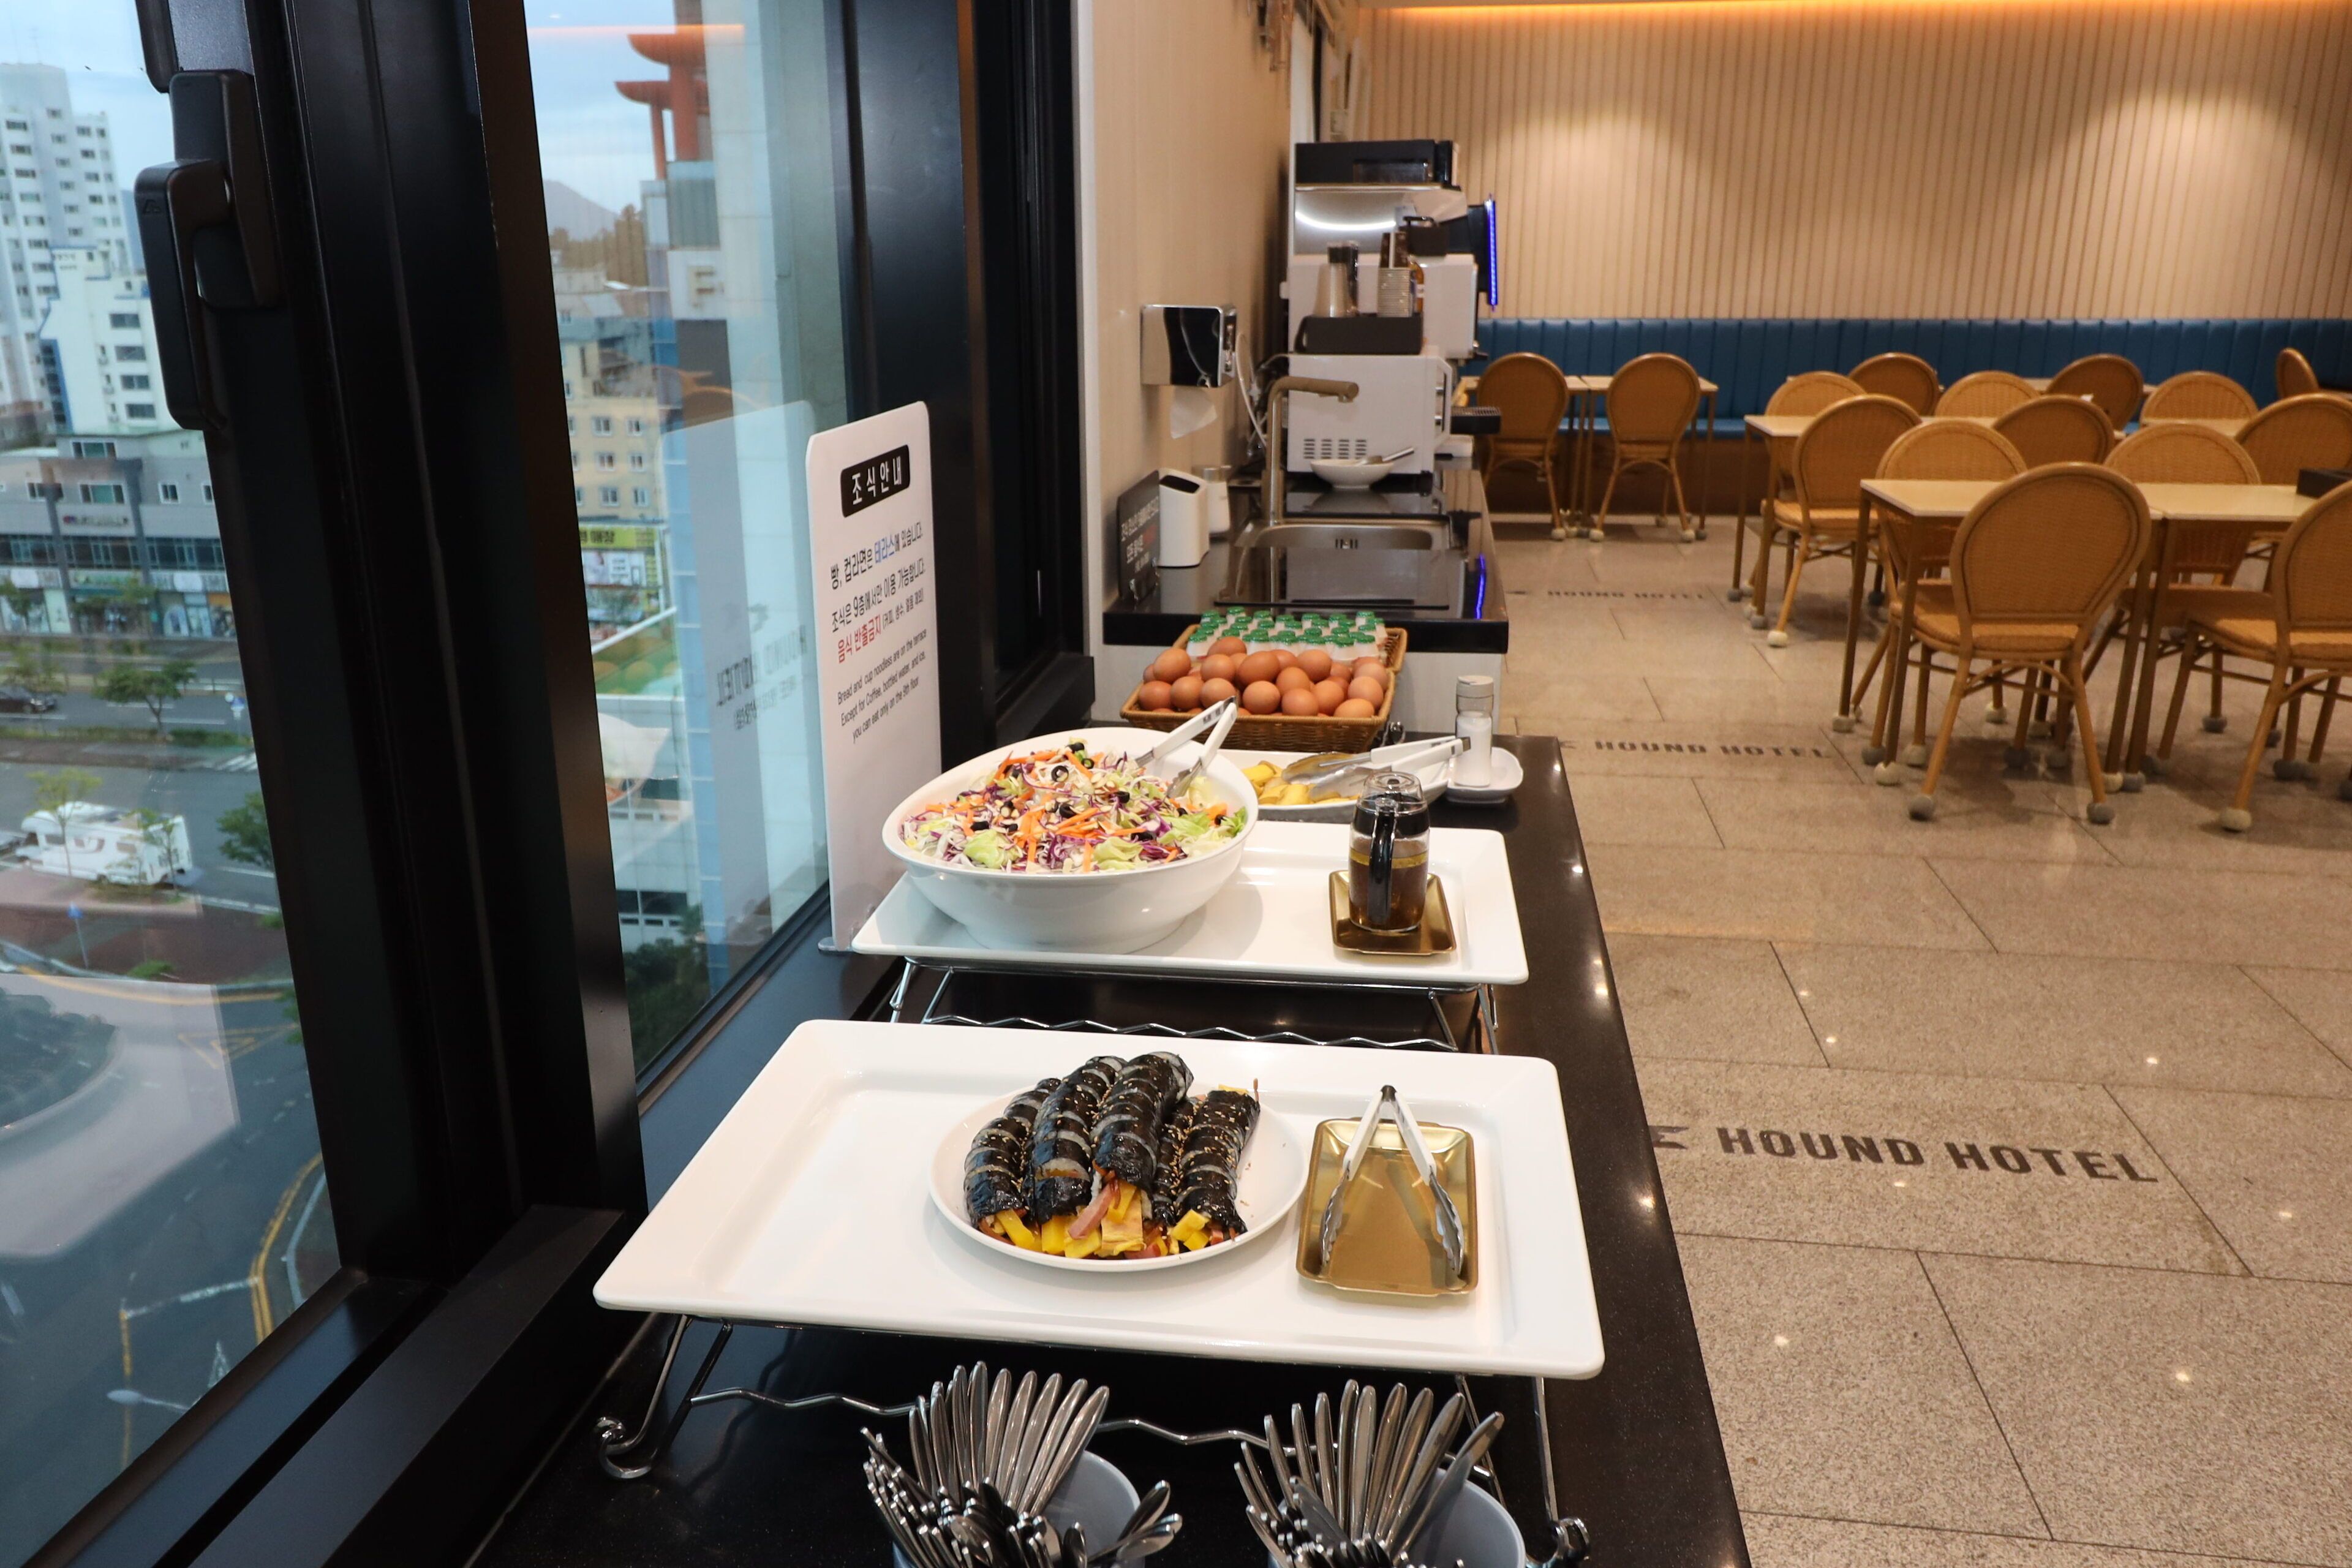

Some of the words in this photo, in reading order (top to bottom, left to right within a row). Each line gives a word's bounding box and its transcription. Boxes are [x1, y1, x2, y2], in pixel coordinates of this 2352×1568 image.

[851, 455, 902, 505] 조식안내
[831, 563, 842, 590] 빵,
[843, 548, 873, 583] 컵라면은
[874, 532, 900, 564] 테라스에
[901, 521, 924, 549] 있습니다.
[832, 603, 852, 633] 조식은
[853, 582, 882, 618] 9층에서만
[883, 573, 897, 598] 이용
[897, 557, 925, 589] 가능합니다.
[837, 682, 853, 706] Bread
[853, 676, 862, 694] and
[864, 671, 873, 685] cup
[900, 645, 907, 656] on
[913, 628, 927, 646] terrace
[838, 634, 852, 663] 음식
[854, 613, 882, 652] 반출금지
[840, 704, 858, 727] Except
[883, 672, 899, 693] bottled
[911, 655, 919, 669] and
[853, 726, 862, 744] you
[862, 717, 871, 732] can
[871, 709, 880, 725] eat
[880, 701, 889, 717] only
[889, 696, 895, 709] on
[910, 676, 919, 691] floor
[1594, 740, 1708, 755] HOUND
[1719, 745, 1831, 759] HOTEL
[1716, 1126, 1925, 1167] HOUND
[1943, 1140, 2160, 1184] HOTEL
